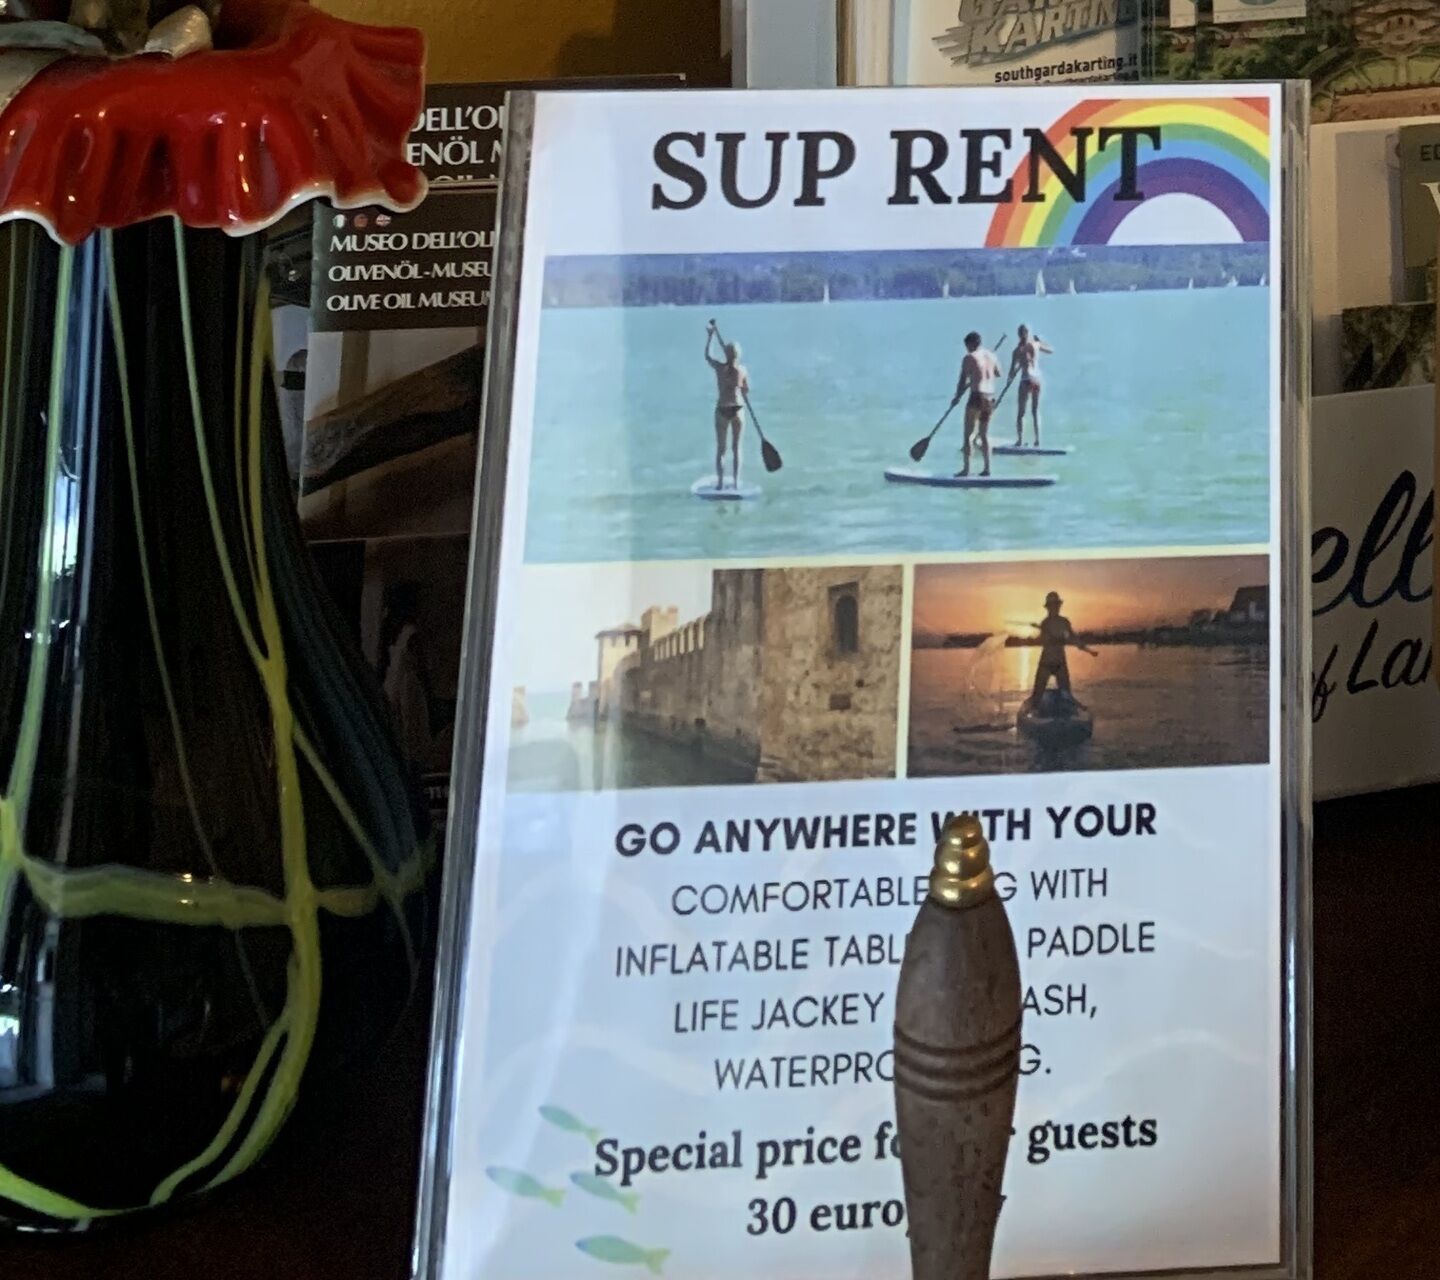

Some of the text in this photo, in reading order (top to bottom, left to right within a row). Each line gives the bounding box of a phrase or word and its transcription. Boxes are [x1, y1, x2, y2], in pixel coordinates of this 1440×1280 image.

[995, 53, 1138, 83] southgardakarting.it
[650, 125, 1164, 212] SUP RENT
[330, 232, 409, 252] MUSEO
[326, 290, 490, 313] OLIVE OIL MUSEU
[1346, 617, 1432, 695] La
[615, 821, 681, 857] GO
[693, 812, 917, 855] ANYWHERE
[1046, 802, 1157, 841] YOUR
[671, 876, 930, 915] COMFORTABLE
[1030, 867, 1108, 901] WITH
[616, 938, 809, 977] INFLATABLE
[1027, 921, 1156, 959] PADDLE
[674, 999, 739, 1034] LIFE
[752, 992, 885, 1031] JACKEY
[595, 1129, 742, 1187] Special
[756, 1126, 862, 1180] price
[1026, 1115, 1158, 1165] guests
[747, 1195, 797, 1236] 30
